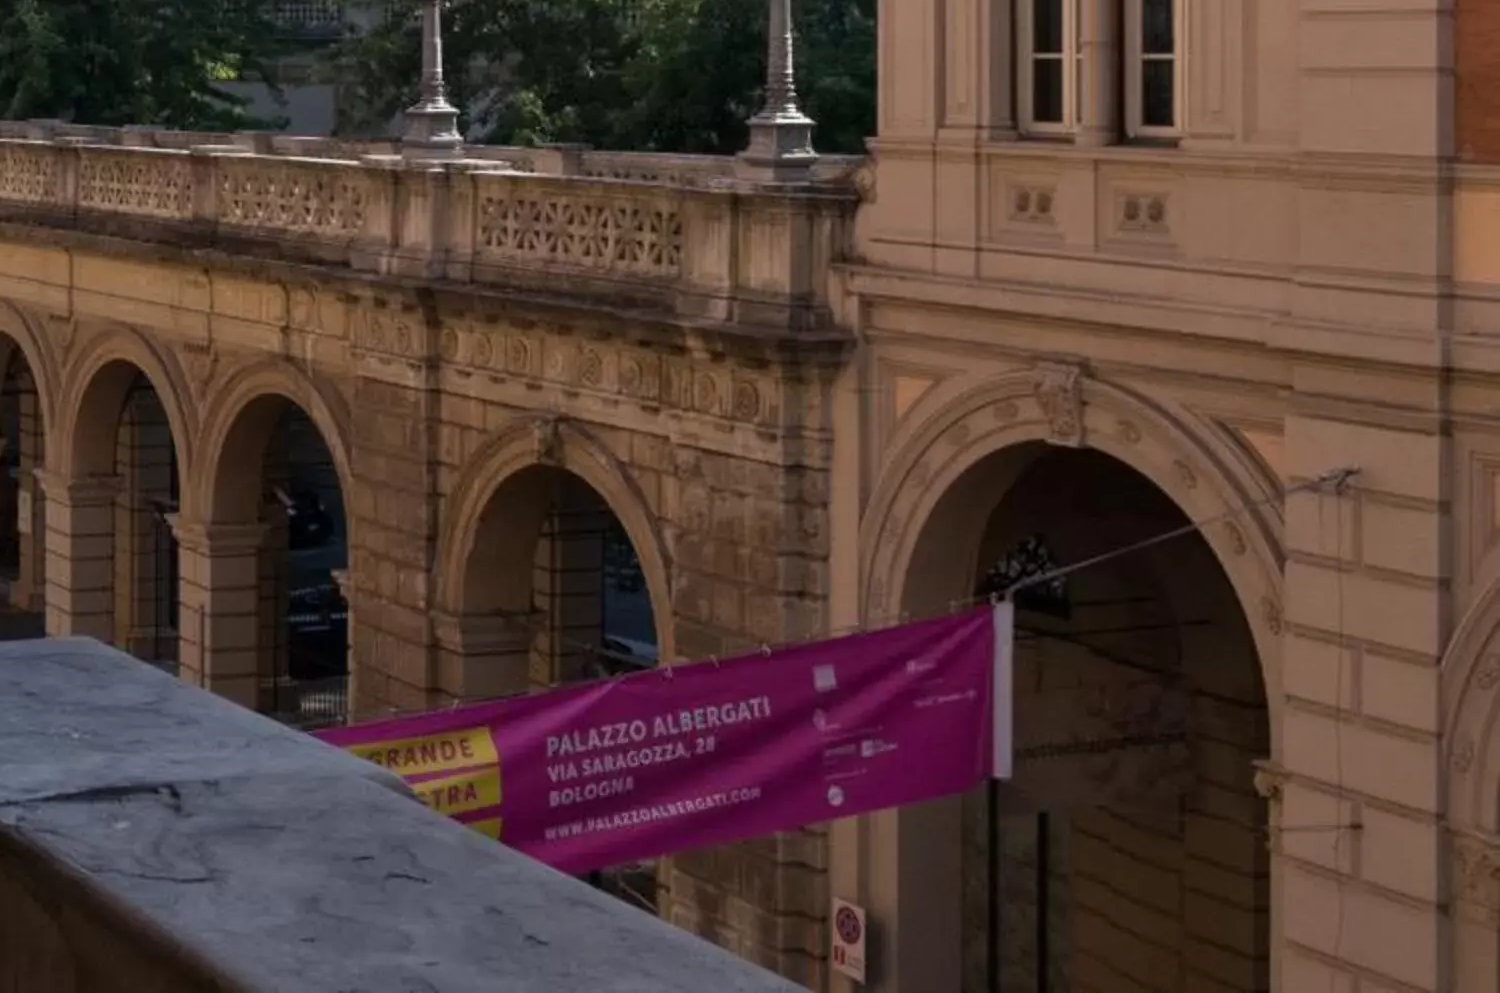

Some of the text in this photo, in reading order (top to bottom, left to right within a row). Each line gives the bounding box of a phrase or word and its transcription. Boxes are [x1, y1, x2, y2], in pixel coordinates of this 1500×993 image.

[546, 719, 648, 758] PALAZZO
[653, 694, 772, 736] ALBERGATI
[368, 738, 474, 767] GRANDE
[547, 736, 716, 783] VIA SARAGOZZA, 28
[420, 781, 477, 808] TRA
[548, 775, 635, 807] BOLOGNA
[544, 786, 762, 841] WWW.PALAZZOALBERGATI.COM
